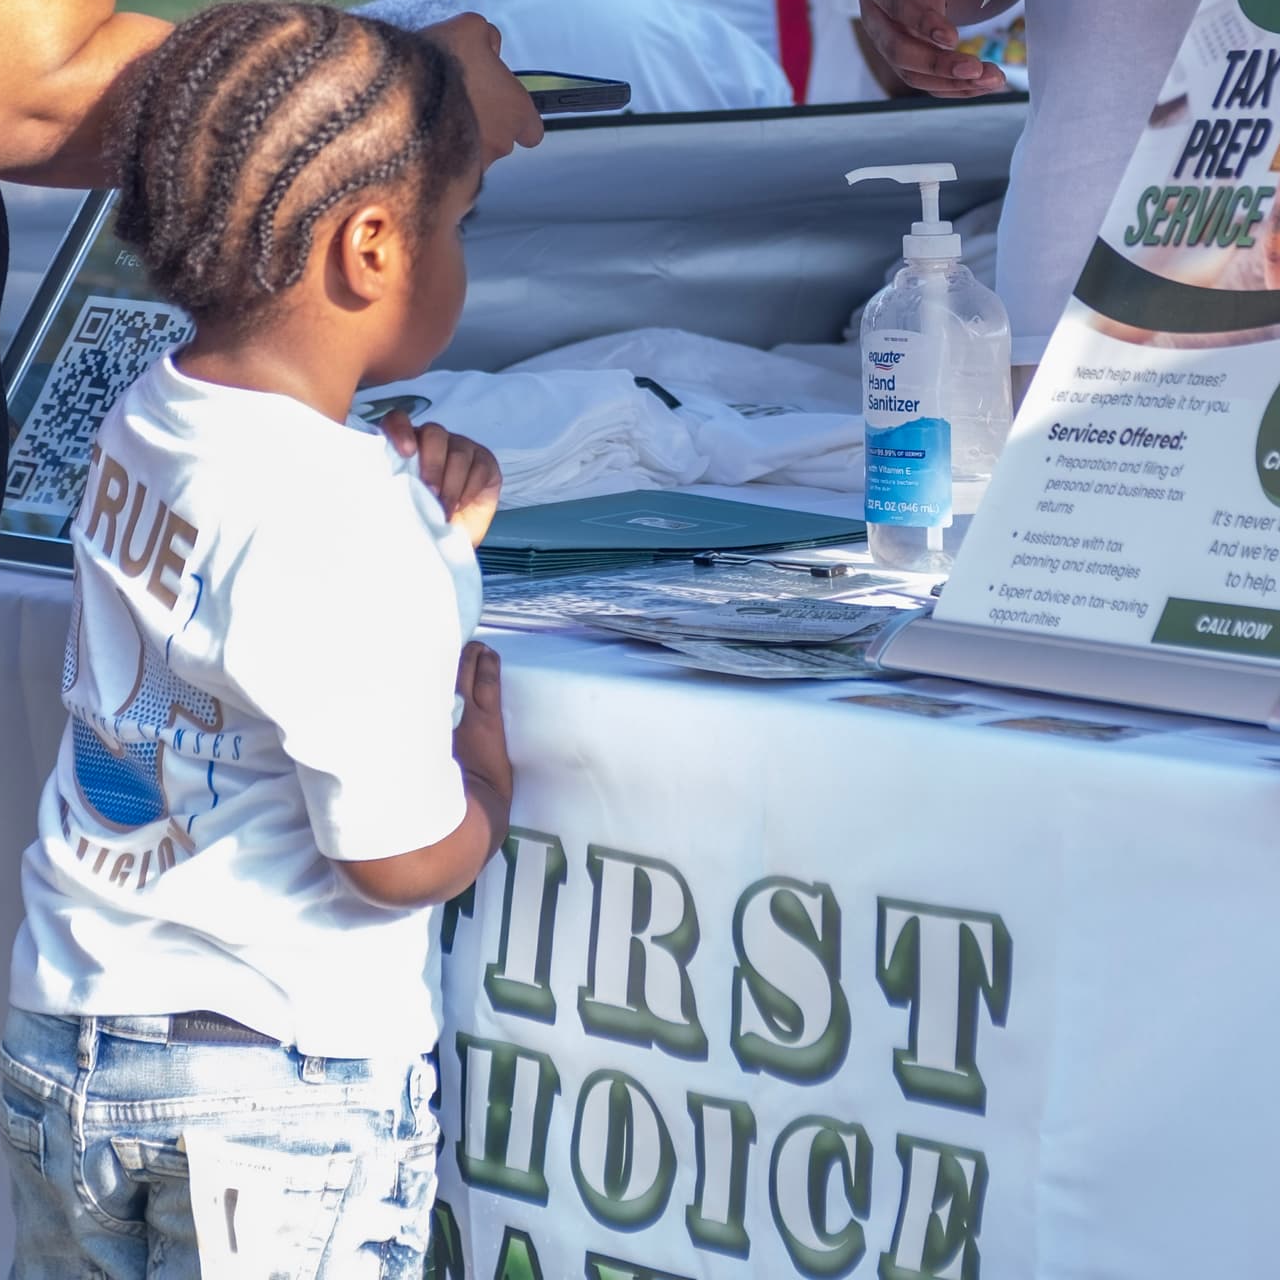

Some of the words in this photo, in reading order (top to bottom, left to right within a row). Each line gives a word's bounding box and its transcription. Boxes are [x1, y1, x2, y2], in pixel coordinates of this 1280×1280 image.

[1172, 118, 1273, 180] PREP
[1123, 185, 1277, 249] SERVICE
[868, 373, 896, 391] Hand
[1073, 365, 1105, 380] Need
[1105, 367, 1132, 386] help
[1132, 369, 1158, 384] with
[1159, 371, 1186, 388] your
[1187, 372, 1227, 388] taxes?
[868, 393, 921, 413] Sanitizer
[1070, 391, 1091, 404] our
[1091, 392, 1134, 410] experts
[1134, 393, 1177, 410] handle
[1177, 396, 1187, 410] it
[1187, 396, 1207, 413] for
[1048, 421, 1117, 445] Services
[1119, 426, 1188, 451] Offered:
[905, 466, 912, 476] E
[1055, 454, 1118, 472] Preparation
[1119, 460, 1142, 474] and
[1142, 461, 1169, 480] filing
[1170, 463, 1184, 478] of
[1044, 478, 1095, 493] personal
[1094, 482, 1118, 495] and
[1118, 484, 1166, 500] business
[1167, 487, 1186, 501] tax
[1036, 499, 1075, 514] returns
[85, 441, 199, 612] RUE
[1212, 509, 1233, 528] It's
[1233, 513, 1276, 532] never
[1023, 530, 1080, 548] Assistance
[1081, 536, 1106, 551] with
[1105, 539, 1124, 553] tax
[1208, 539, 1240, 558] And
[1240, 543, 1280, 562] we're
[1011, 552, 1061, 574] planning
[1062, 559, 1086, 573] and
[1085, 561, 1141, 582] strategies
[1224, 571, 1242, 588] to
[1242, 571, 1278, 597] help.
[998, 583, 1033, 601] Expert
[1033, 588, 1070, 605] advice
[1071, 595, 1087, 607] on
[1088, 594, 1149, 619] tax-saving
[988, 607, 1062, 627] opportunities
[1195, 615, 1233, 636] CALL
[1231, 620, 1274, 641] NOW
[439, 824, 1013, 1117] IRST
[423, 1031, 990, 1280] HOICE
